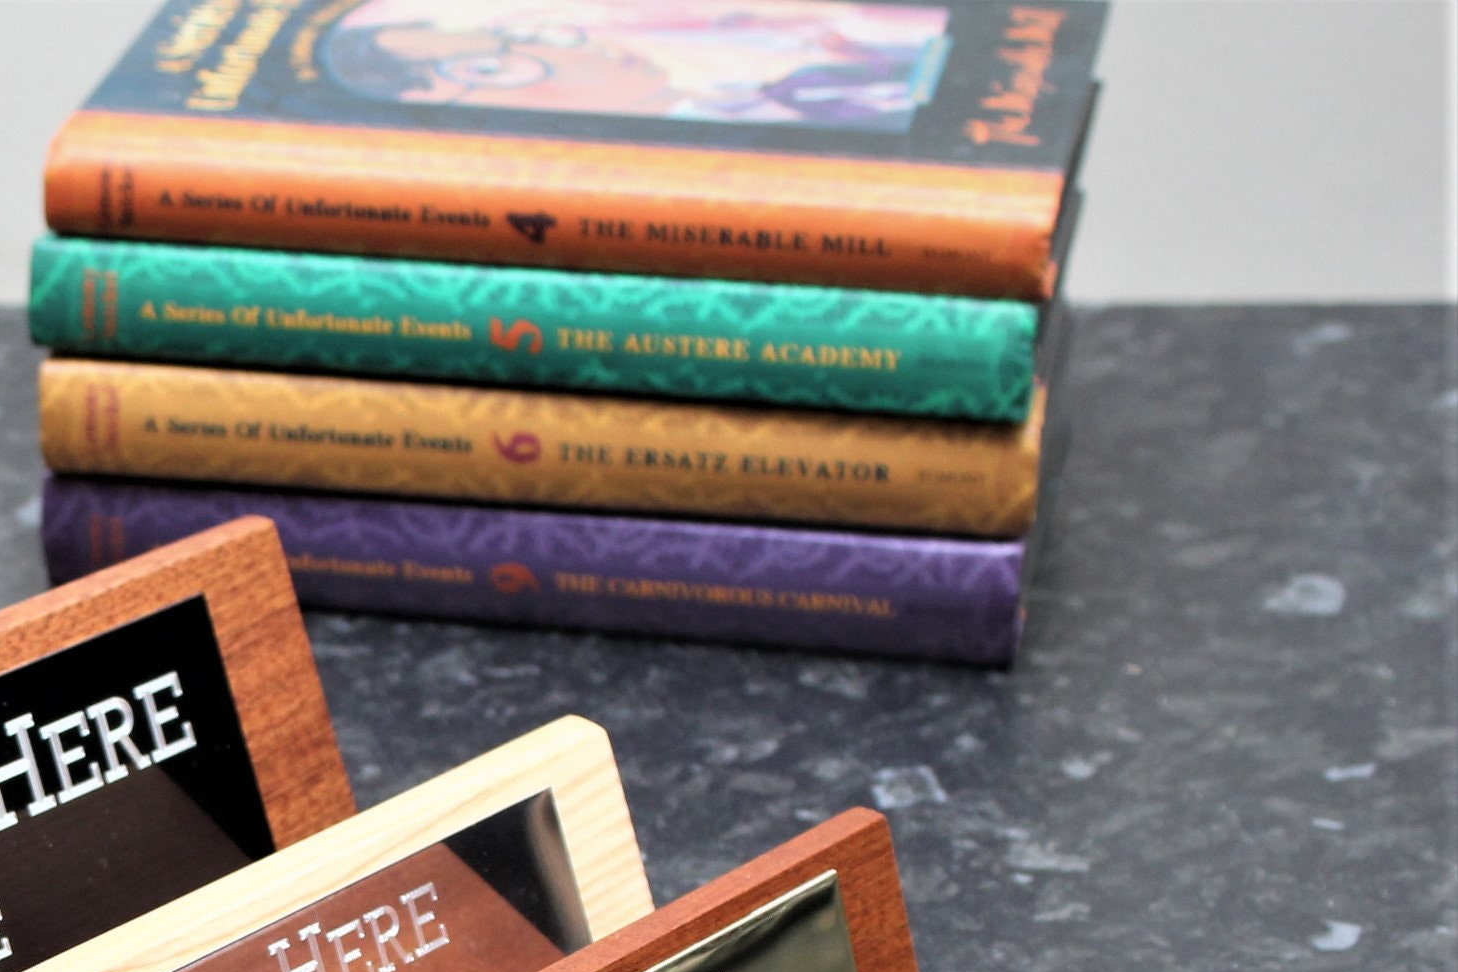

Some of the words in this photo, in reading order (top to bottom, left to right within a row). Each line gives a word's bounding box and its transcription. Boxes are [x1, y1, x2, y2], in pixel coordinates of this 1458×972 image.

[159, 192, 173, 207] A
[182, 192, 243, 213] Series
[250, 193, 278, 213] Of
[285, 197, 413, 224] Unfortunate
[420, 206, 491, 229] Events
[507, 212, 557, 244] 4
[579, 217, 632, 240] THE
[646, 221, 810, 251] MISERABLE
[822, 234, 893, 258] MILL
[140, 303, 158, 319] A
[164, 302, 228, 326] Series
[236, 305, 261, 326] Of
[267, 308, 393, 334] Unfortunate
[399, 317, 473, 341] Events
[490, 317, 542, 354] 5
[557, 328, 614, 352] THE
[624, 331, 750, 361] AUSTERE
[761, 344, 902, 372] ACADEMY
[144, 418, 159, 434] A
[168, 417, 229, 439] Series
[235, 420, 263, 440] Of
[269, 424, 395, 449] Unfortunate
[403, 431, 473, 455] Events
[493, 431, 542, 464] 6
[558, 443, 612, 464] THE
[625, 447, 729, 471] ERSATZ
[742, 454, 890, 483] ELEVATOR
[289, 554, 396, 578] nfortunate
[402, 559, 473, 584] Events
[490, 562, 540, 593] 9
[556, 571, 603, 594] THE
[778, 589, 897, 617] CARNIVAL
